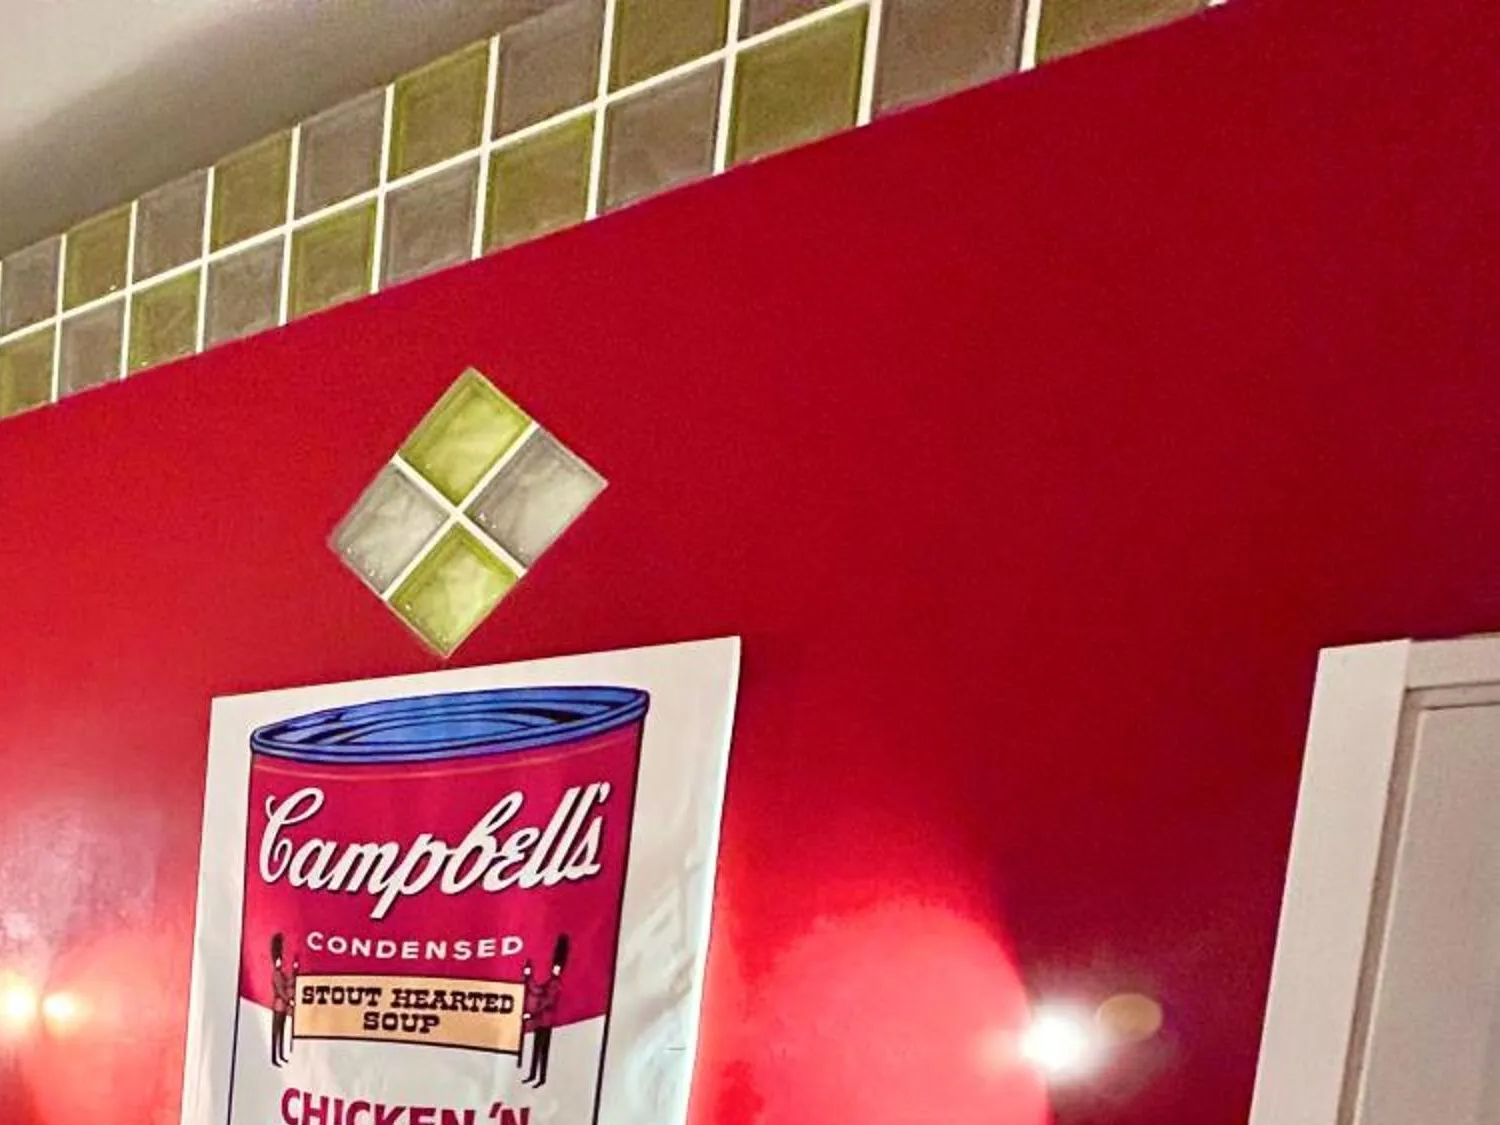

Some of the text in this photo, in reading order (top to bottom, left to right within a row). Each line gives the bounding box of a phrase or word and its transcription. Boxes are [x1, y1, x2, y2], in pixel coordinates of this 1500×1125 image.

[260, 781, 610, 919] Campbell's
[307, 931, 523, 960] CONDENSED
[302, 985, 515, 1014] STOUT HEARTED
[363, 1011, 440, 1033] SOUP
